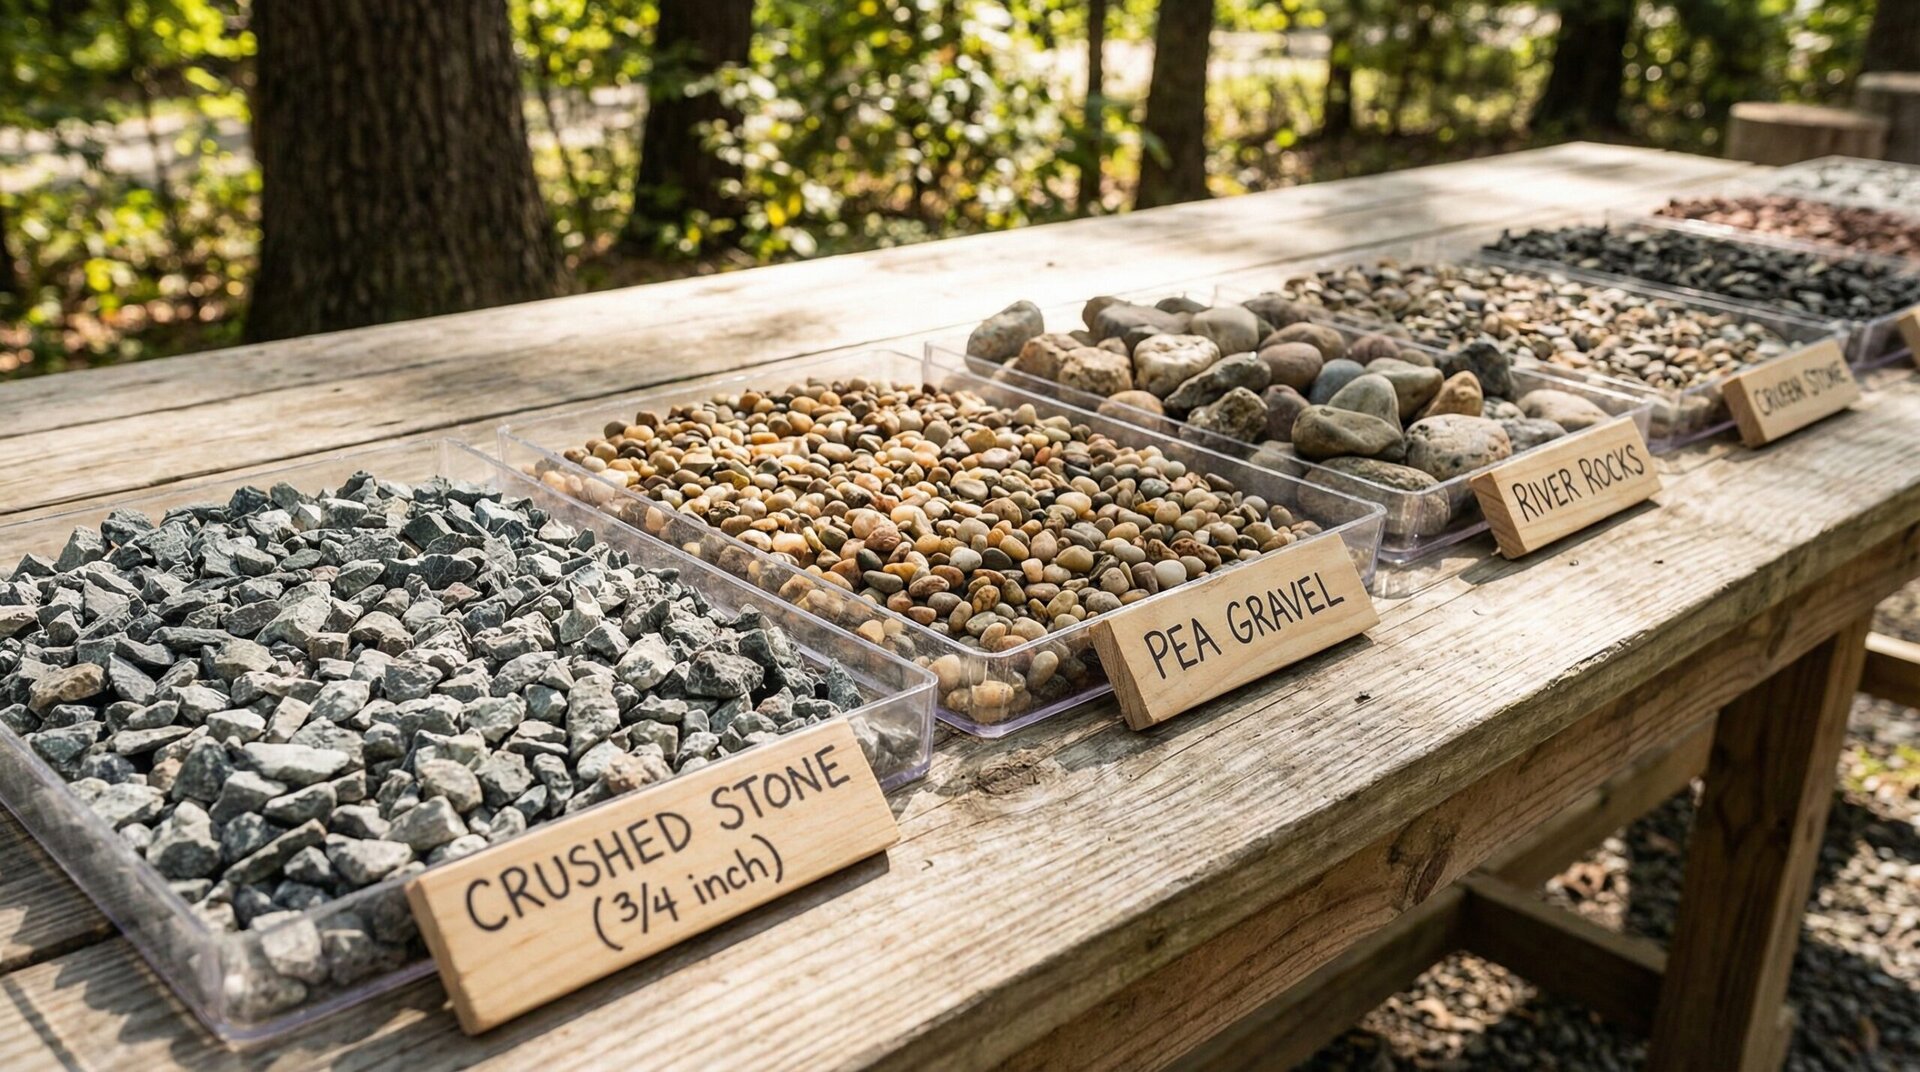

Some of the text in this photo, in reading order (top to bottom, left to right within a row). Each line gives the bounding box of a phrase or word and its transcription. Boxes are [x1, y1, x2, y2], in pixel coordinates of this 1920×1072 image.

[1512, 444, 1645, 522] RIVER ROCKS
[1143, 572, 1345, 679] PEA GRAVEL
[465, 745, 851, 932] CRUSHED STONE
[593, 833, 784, 951] (3/4 inch)
